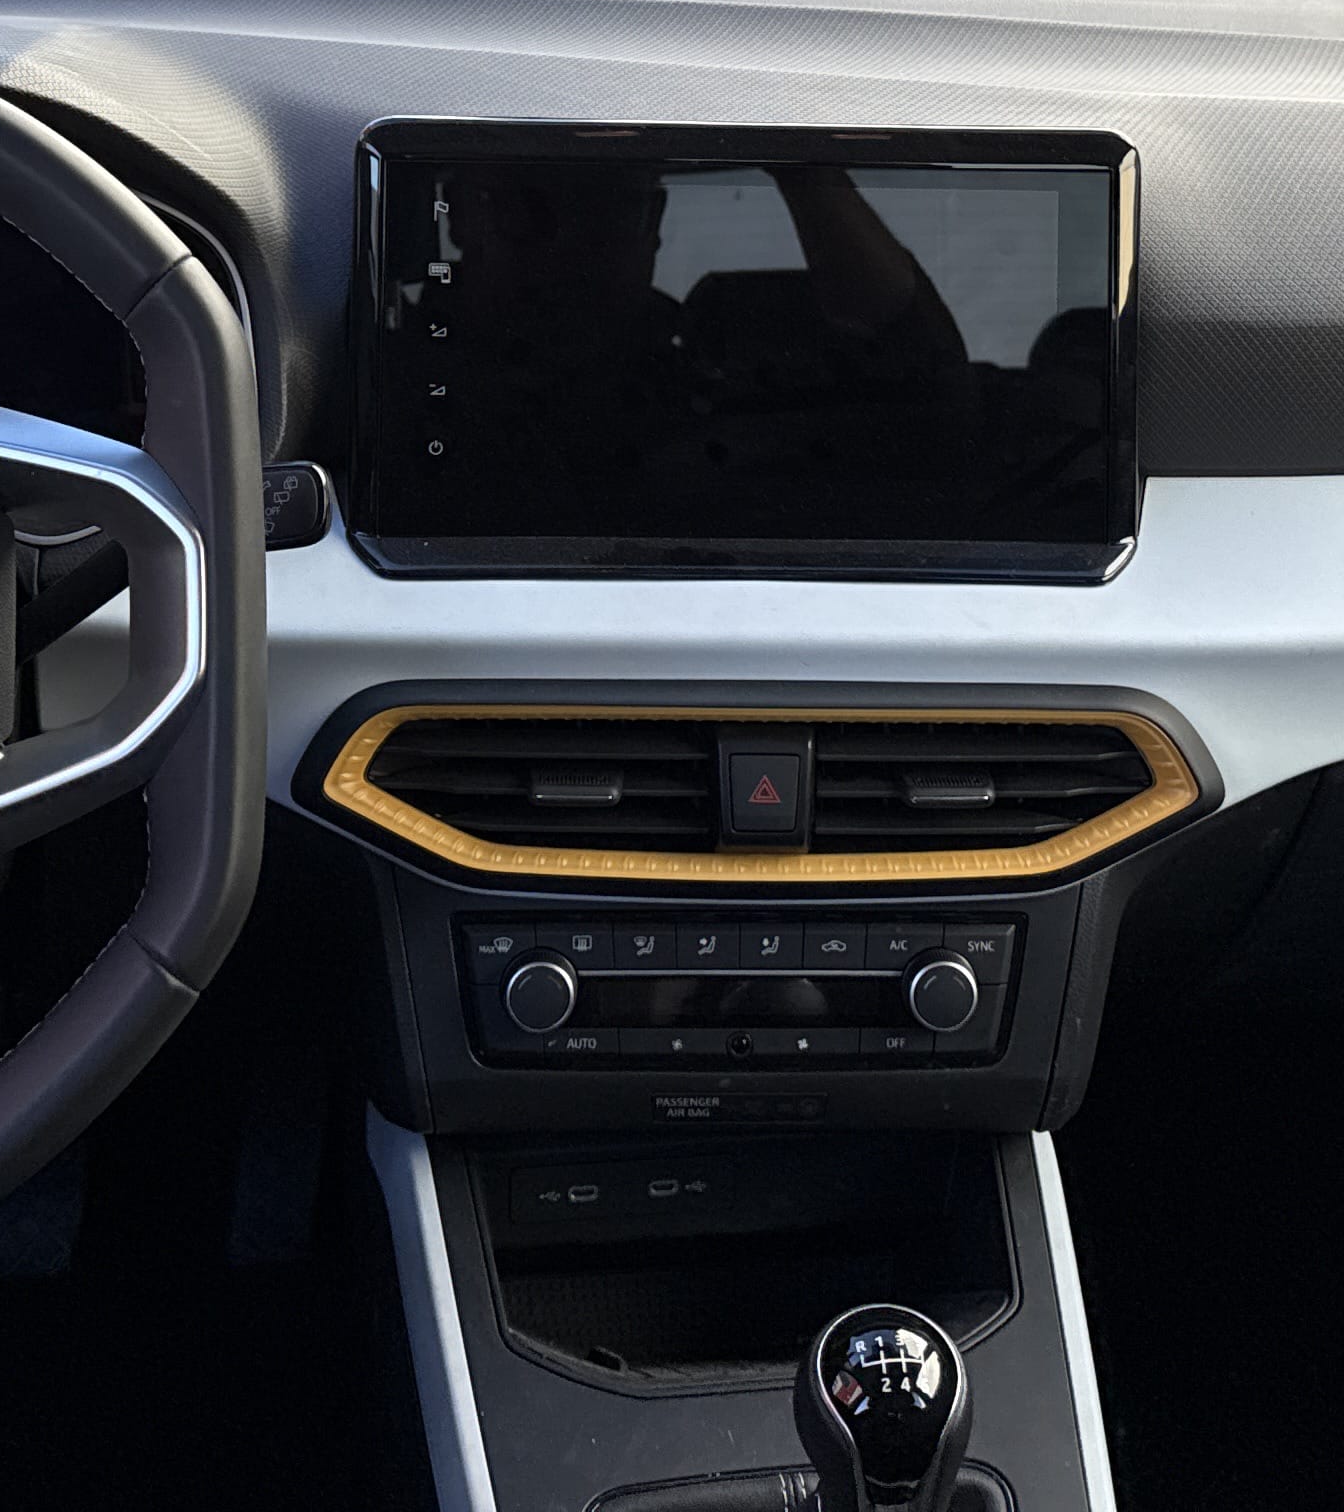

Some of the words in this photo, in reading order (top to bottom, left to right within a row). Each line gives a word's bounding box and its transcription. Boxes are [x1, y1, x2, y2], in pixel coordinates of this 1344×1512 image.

[478, 944, 496, 954] MAX
[889, 939, 908, 952] A/C
[967, 940, 996, 953] SYNC
[566, 1037, 597, 1051] AUTO
[886, 1037, 907, 1050] OFF
[655, 1096, 721, 1107] PASSENGER
[666, 1107, 685, 1118] AIR
[687, 1107, 710, 1118] BAG
[855, 1340, 867, 1353] R
[874, 1336, 884, 1347] 1
[880, 1377, 892, 1393] 2
[901, 1376, 911, 1392] 4
